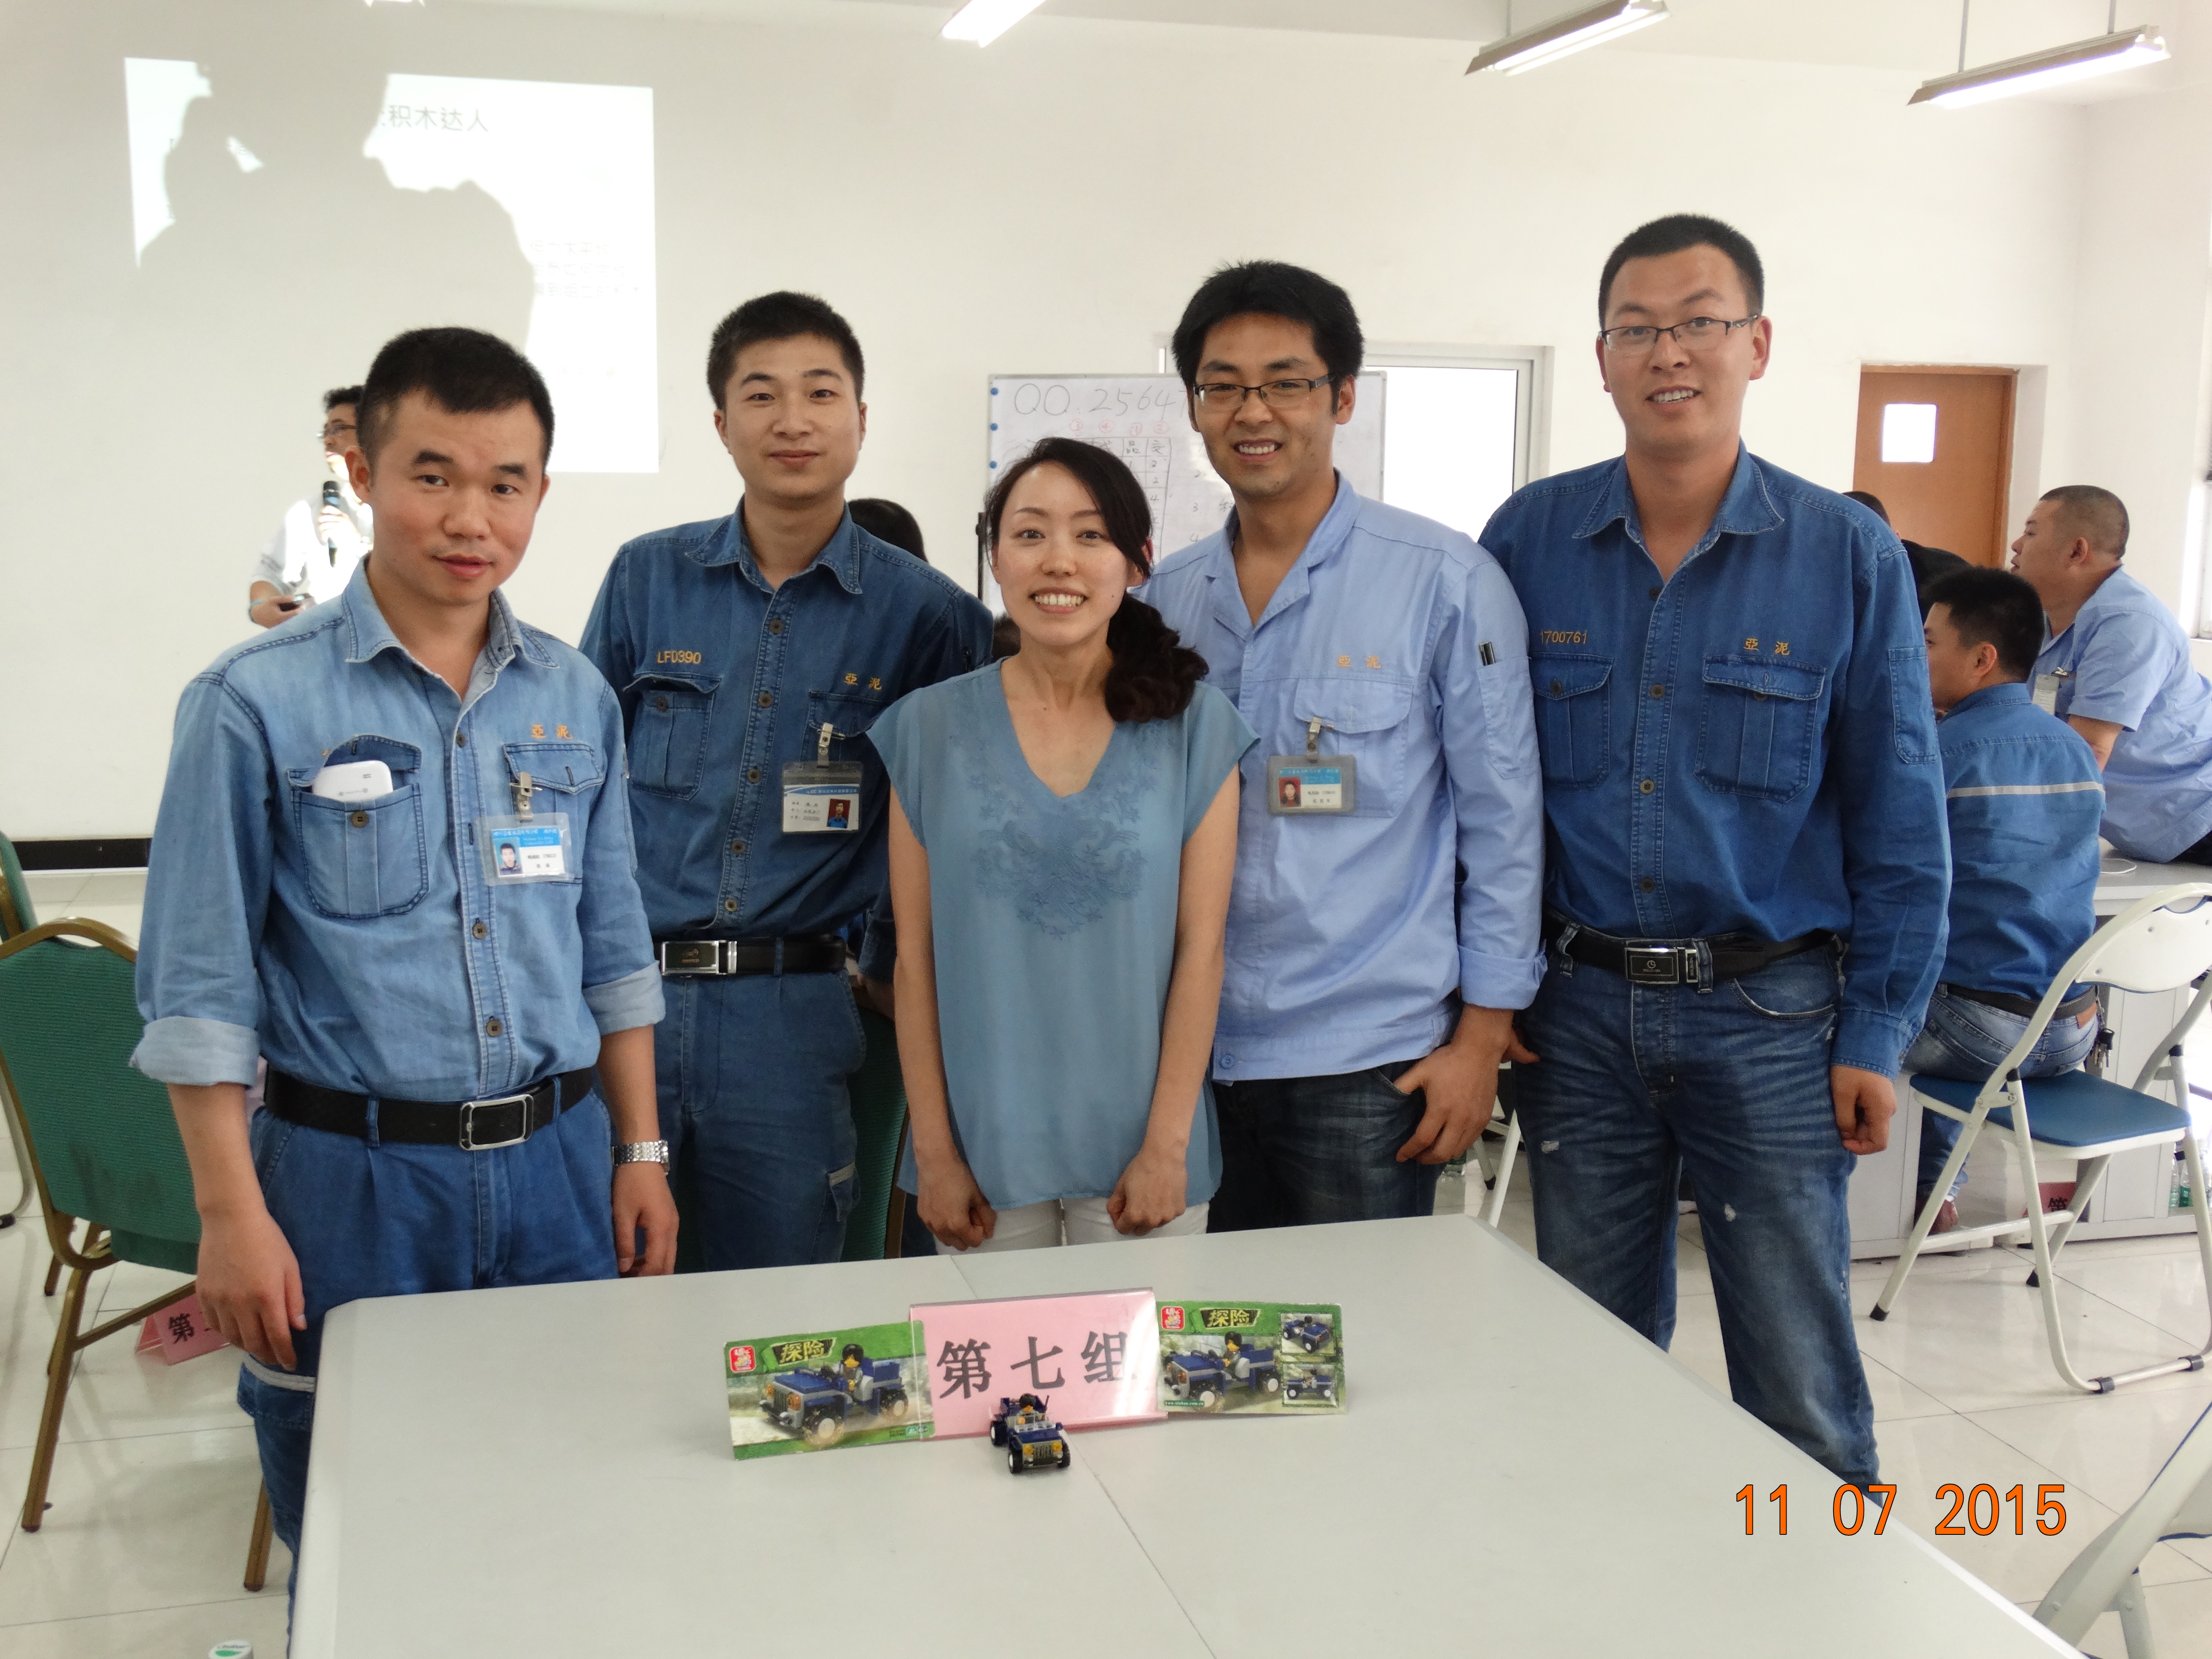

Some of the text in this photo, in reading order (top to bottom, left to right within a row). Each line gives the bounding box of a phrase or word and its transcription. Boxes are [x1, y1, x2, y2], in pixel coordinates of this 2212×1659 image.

[381, 105, 489, 133] 积木达人
[1540, 629, 1588, 644] 1700761
[1207, 1309, 1250, 1328] 探险
[779, 1340, 825, 1365] 探险
[937, 1330, 1138, 1399] 第七组
